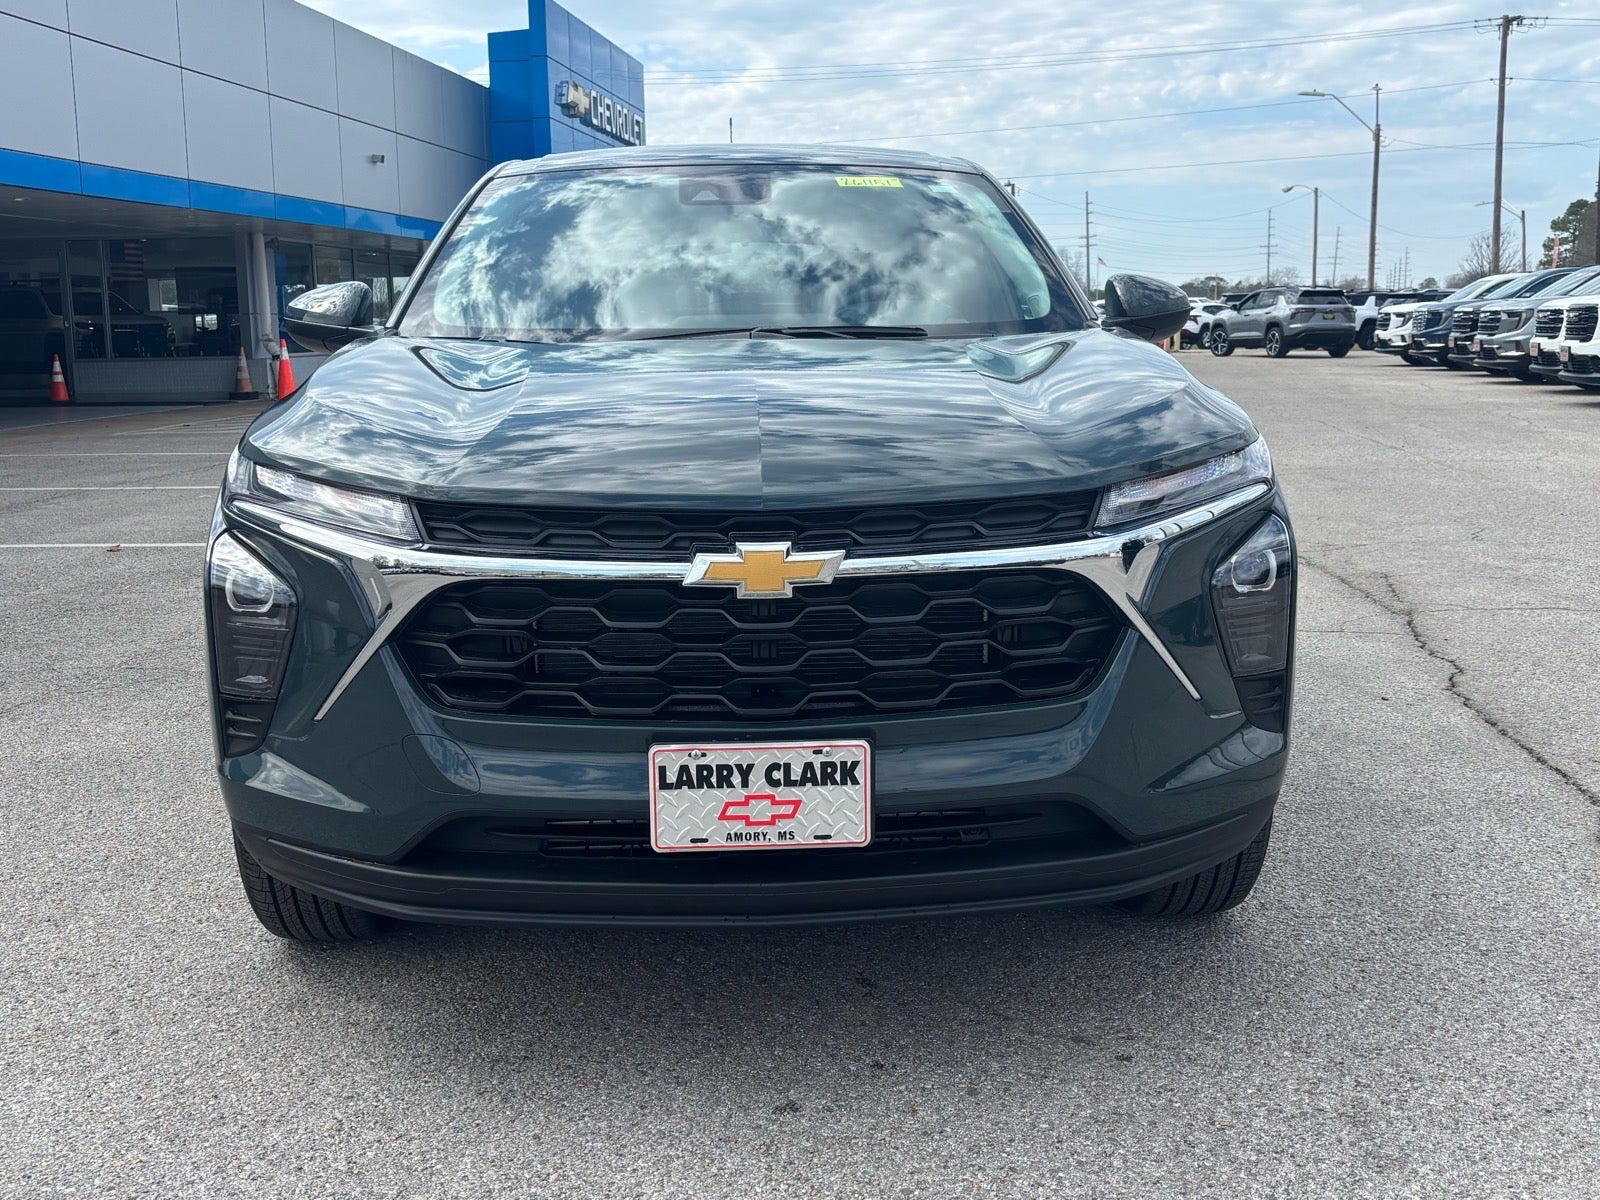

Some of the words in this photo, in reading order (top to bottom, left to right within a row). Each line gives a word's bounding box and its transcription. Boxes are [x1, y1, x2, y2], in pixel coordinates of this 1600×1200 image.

[590, 90, 643, 146] CHEVROLET
[658, 763, 755, 790] LARRY
[764, 760, 860, 787] CLARK
[725, 831, 772, 843] AMORY,
[777, 830, 796, 841] MS
